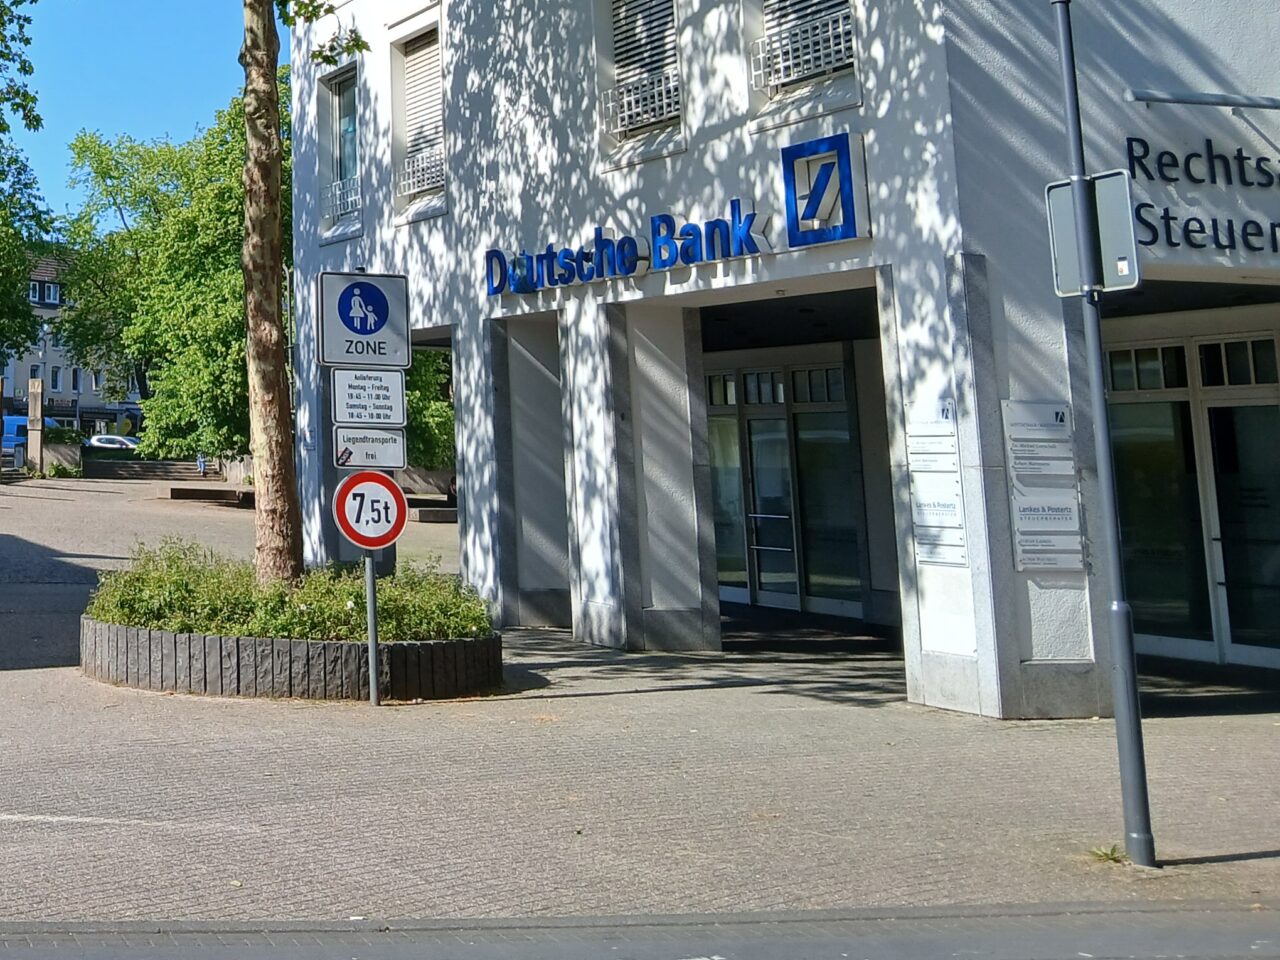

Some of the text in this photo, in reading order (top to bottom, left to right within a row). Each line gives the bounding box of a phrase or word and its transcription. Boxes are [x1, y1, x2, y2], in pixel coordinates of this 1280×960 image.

[1125, 136, 1280, 188] Rechts
[650, 197, 760, 269] Bank
[345, 339, 387, 356] ZONE
[348, 383, 366, 392] Montag
[371, 383, 390, 393] Freitag
[381, 393, 391, 401] Uhr
[345, 402, 368, 411] Samstag
[372, 403, 393, 412] Sonntag
[382, 412, 391, 420] Uhr
[342, 434, 398, 445] Liegendtransporte
[365, 451, 377, 460] frei
[351, 492, 391, 527] 7,5t
